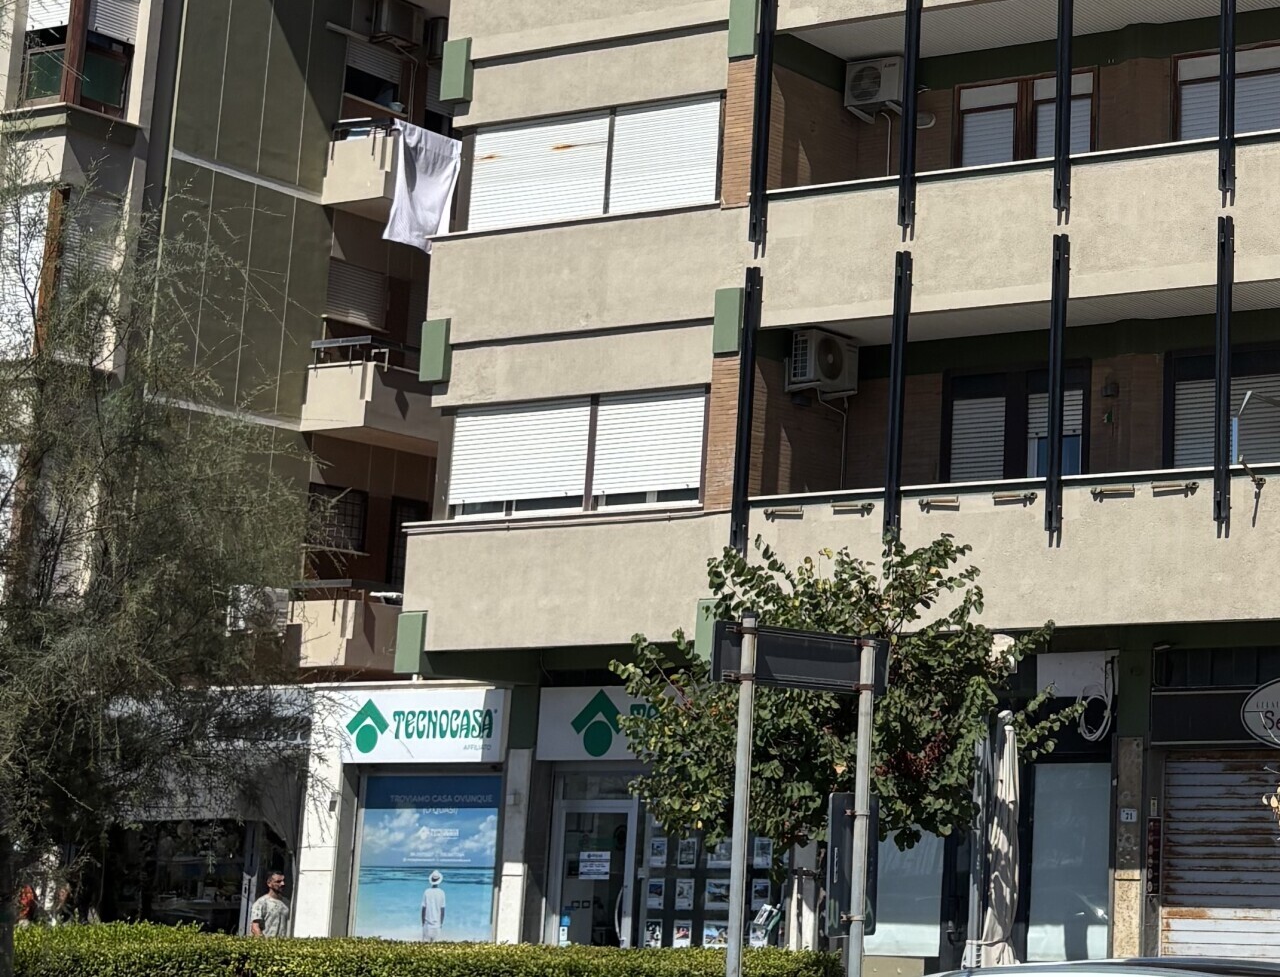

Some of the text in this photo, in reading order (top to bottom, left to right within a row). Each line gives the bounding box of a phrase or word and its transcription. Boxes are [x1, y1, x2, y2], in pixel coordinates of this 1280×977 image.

[393, 709, 493, 739] TECNOCASA
[390, 794, 493, 804] TROVIAMO CASA OVUNQUE
[1125, 812, 1133, 820] 71
